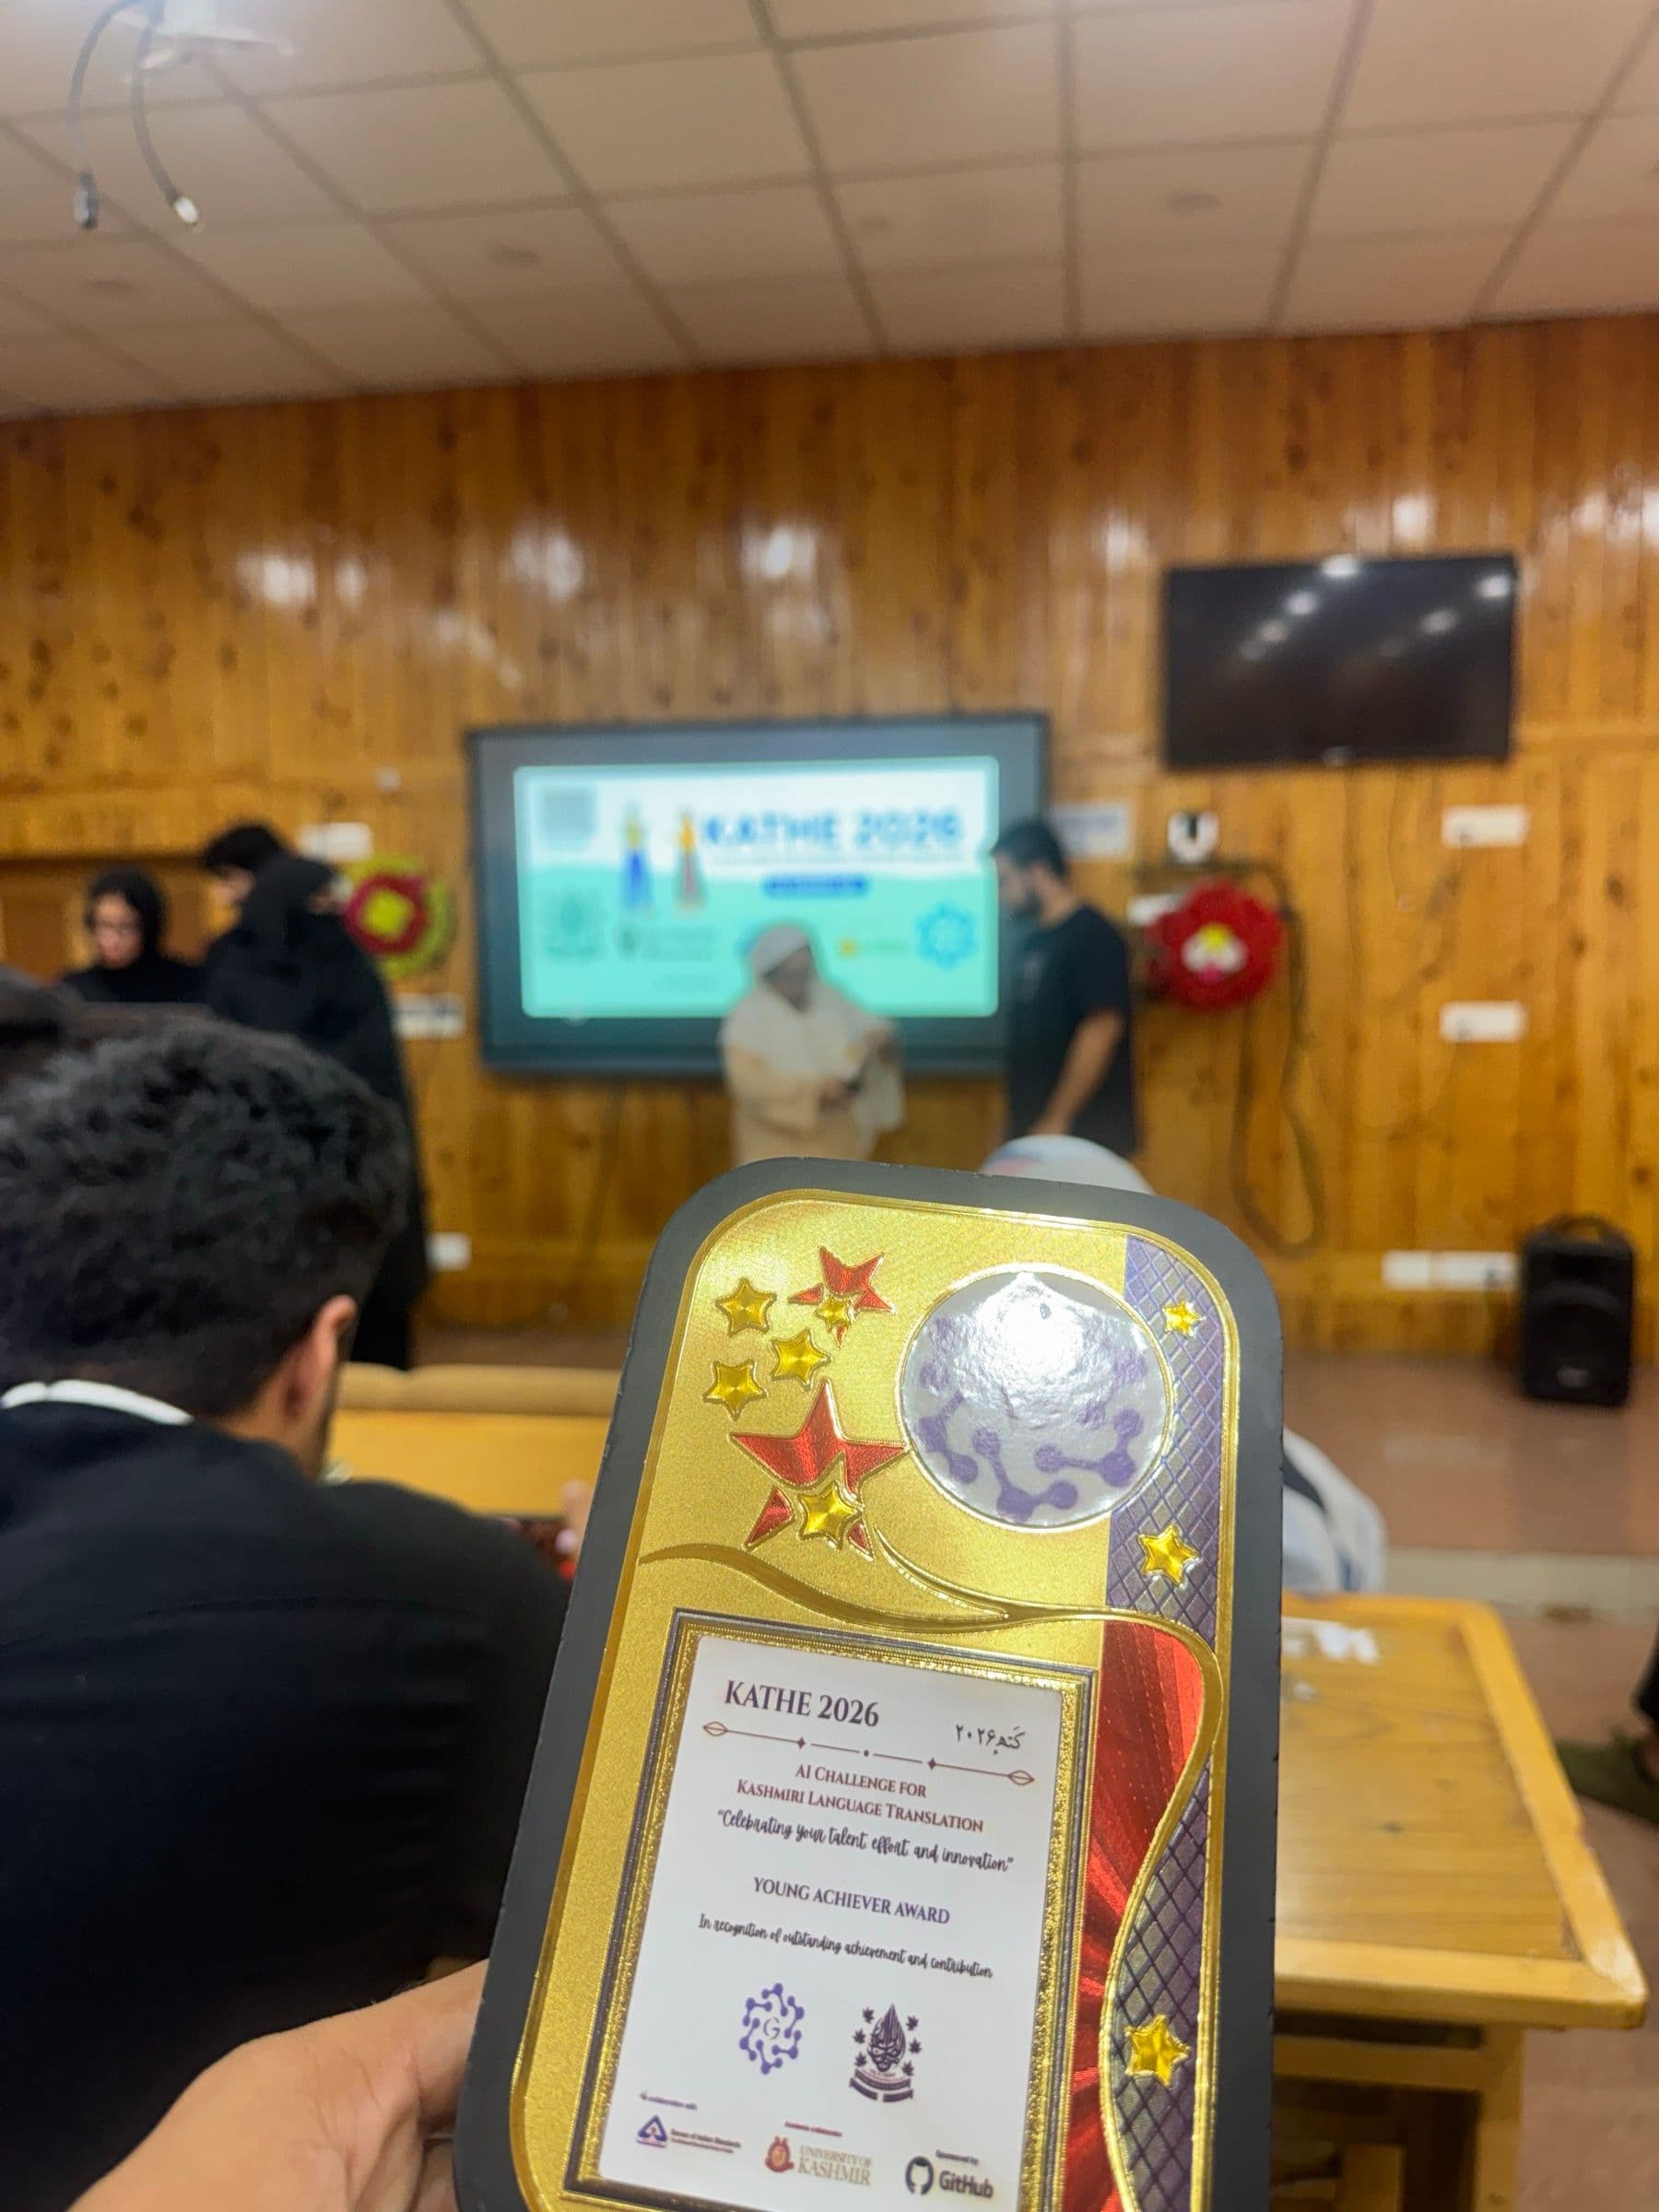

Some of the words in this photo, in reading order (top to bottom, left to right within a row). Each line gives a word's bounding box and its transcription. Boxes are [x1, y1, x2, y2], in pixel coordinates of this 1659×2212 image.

[702, 811, 837, 849] KATHE
[857, 806, 962, 849] 2026
[724, 1679, 812, 1716] KATHE
[818, 1694, 880, 1727] 2026
[795, 1764, 811, 1779] AI
[795, 1823, 827, 1843] your
[913, 1843, 938, 1864] and
[753, 1877, 810, 1900] YOUNG
[813, 1888, 891, 1915] ACHIEVER
[893, 1901, 950, 1924] AWARD
[698, 1912, 712, 1930] In
[713, 1917, 769, 1941] recognition
[770, 1927, 782, 1944] of
[782, 1930, 841, 1955] outstanding
[844, 1940, 907, 1964] achievement
[907, 1949, 928, 1970] and
[930, 1954, 994, 1979] contribution
[798, 2157, 871, 2186] KASHMIR
[799, 2145, 859, 2166] UNIVERSITY
[938, 2170, 994, 2199] GitHub
